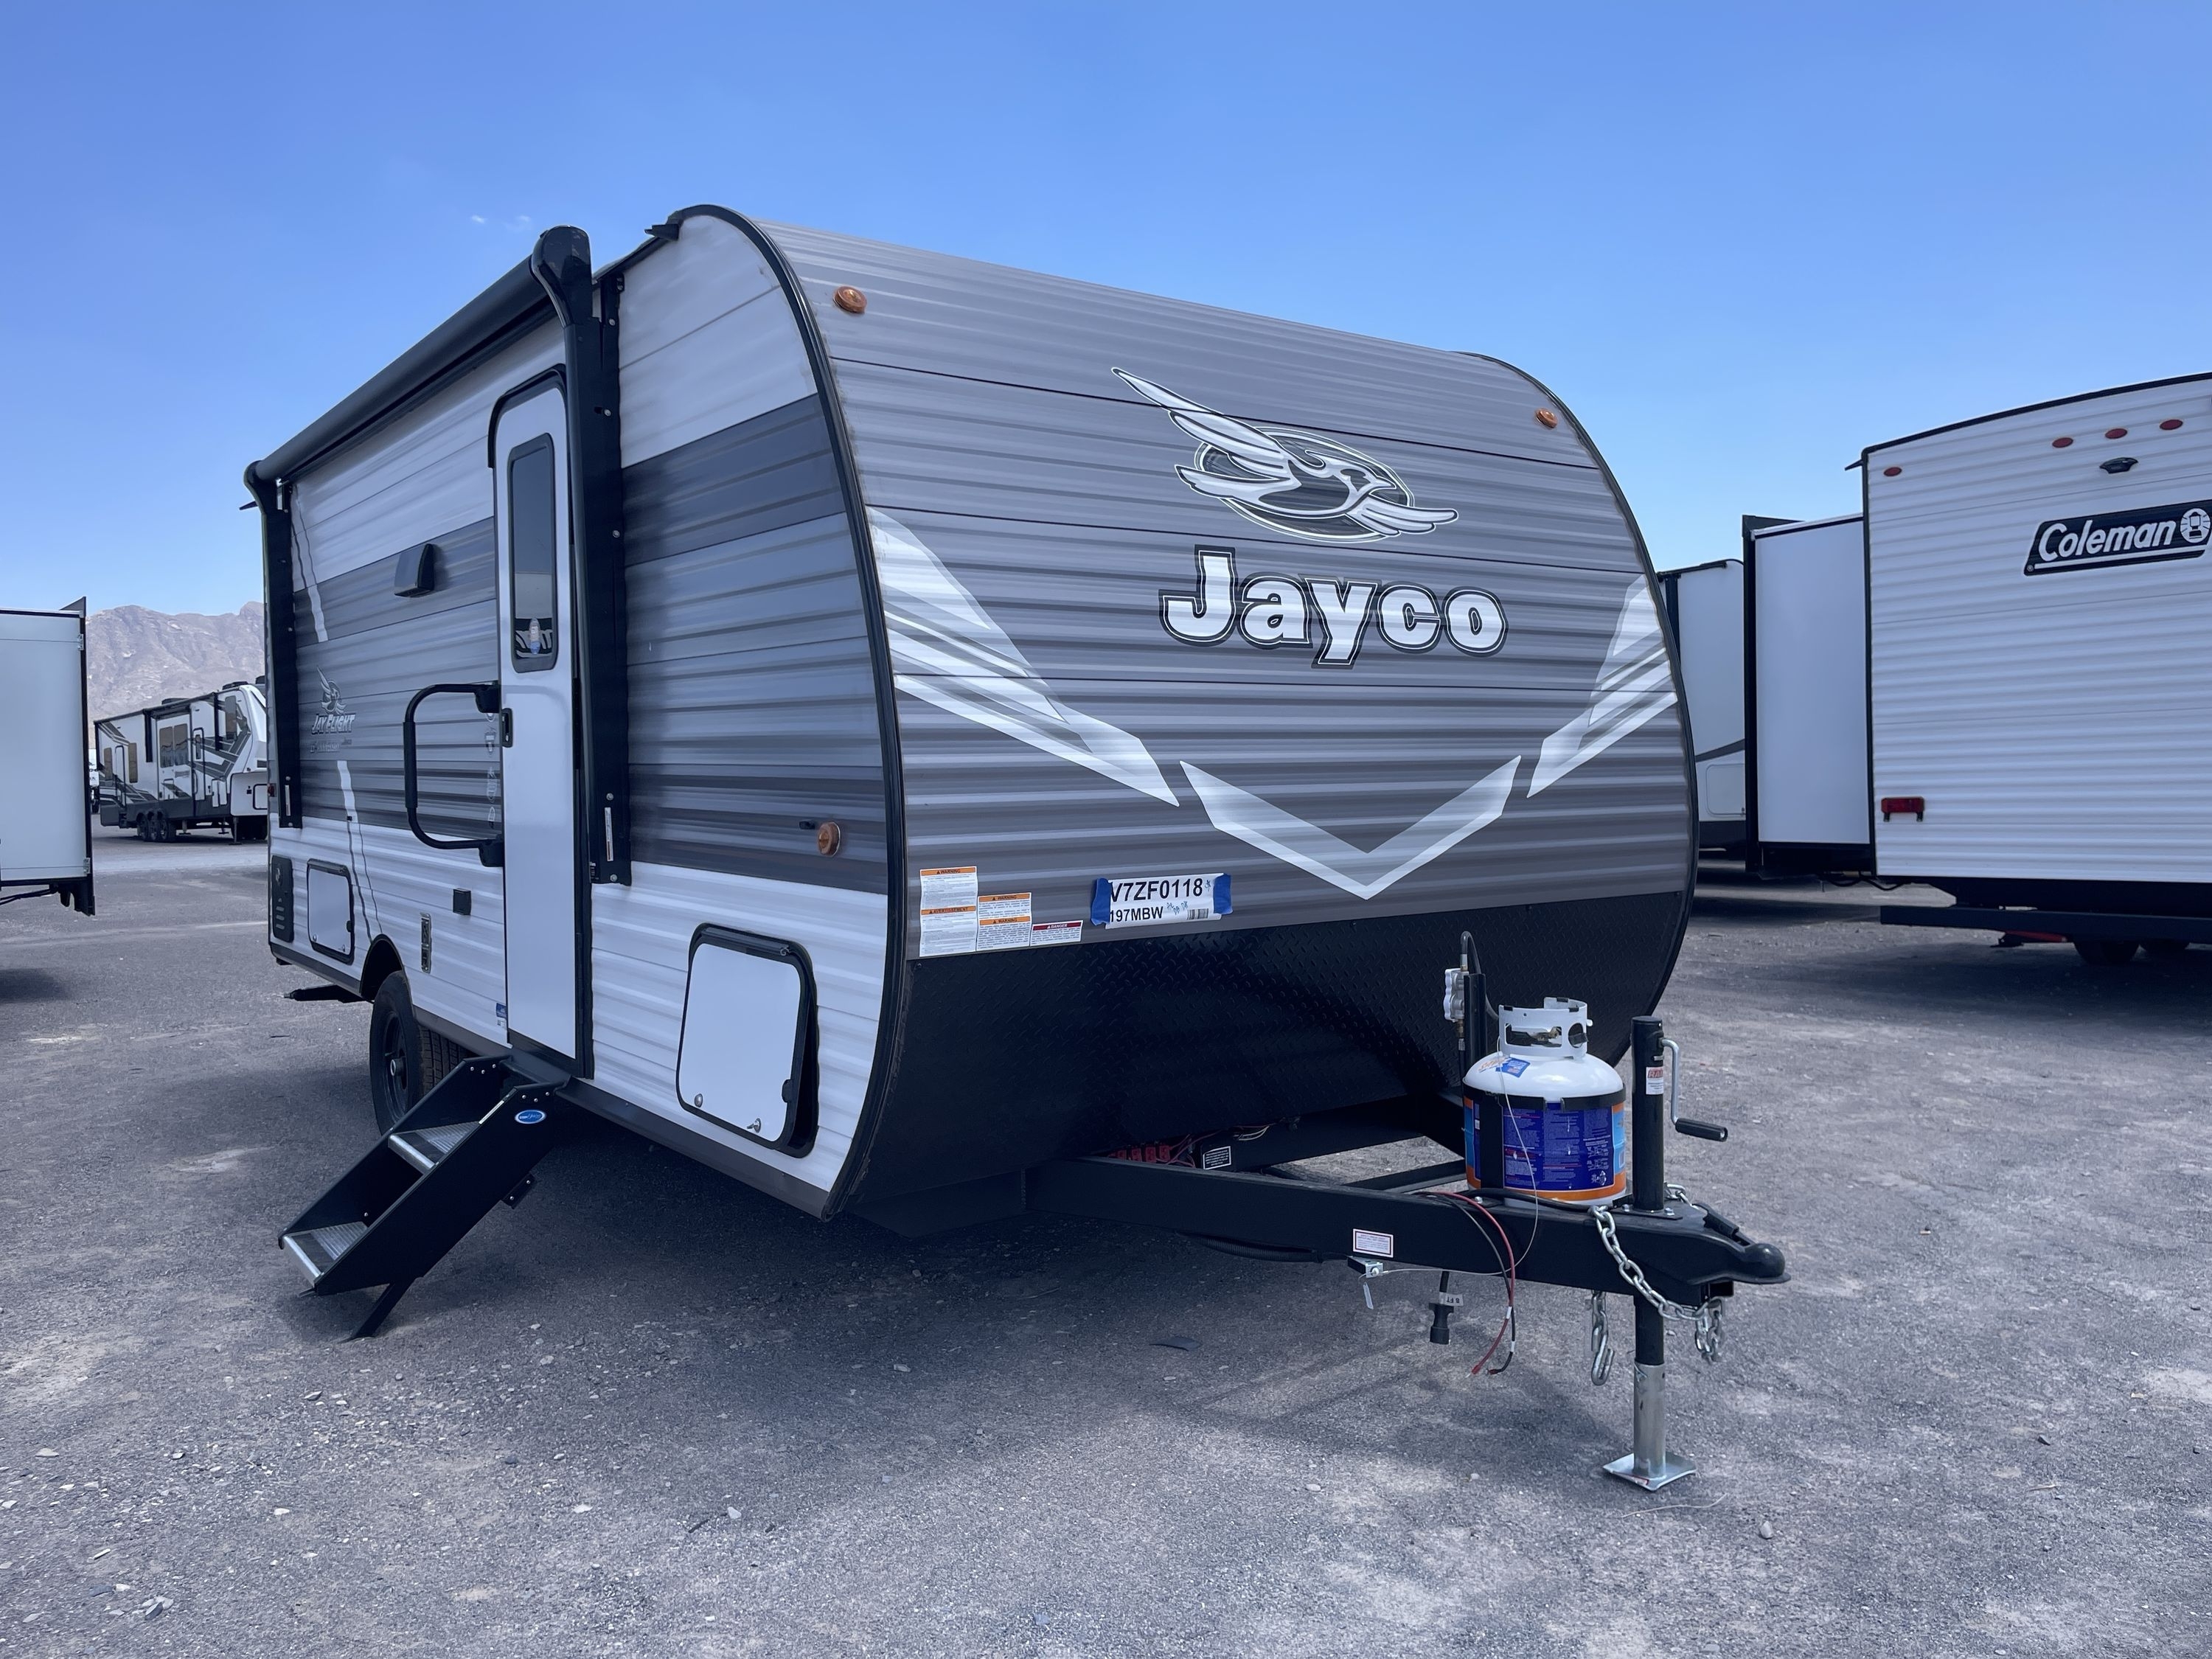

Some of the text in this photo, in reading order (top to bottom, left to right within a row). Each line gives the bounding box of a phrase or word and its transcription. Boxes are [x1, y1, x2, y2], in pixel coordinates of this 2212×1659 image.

[2038, 520, 2177, 562] Coleman
[1158, 544, 1509, 669] Jayco
[325, 712, 356, 734] FLIGHT
[1110, 877, 1203, 902] V7ZF0118
[1110, 906, 1164, 922] 197MBW
